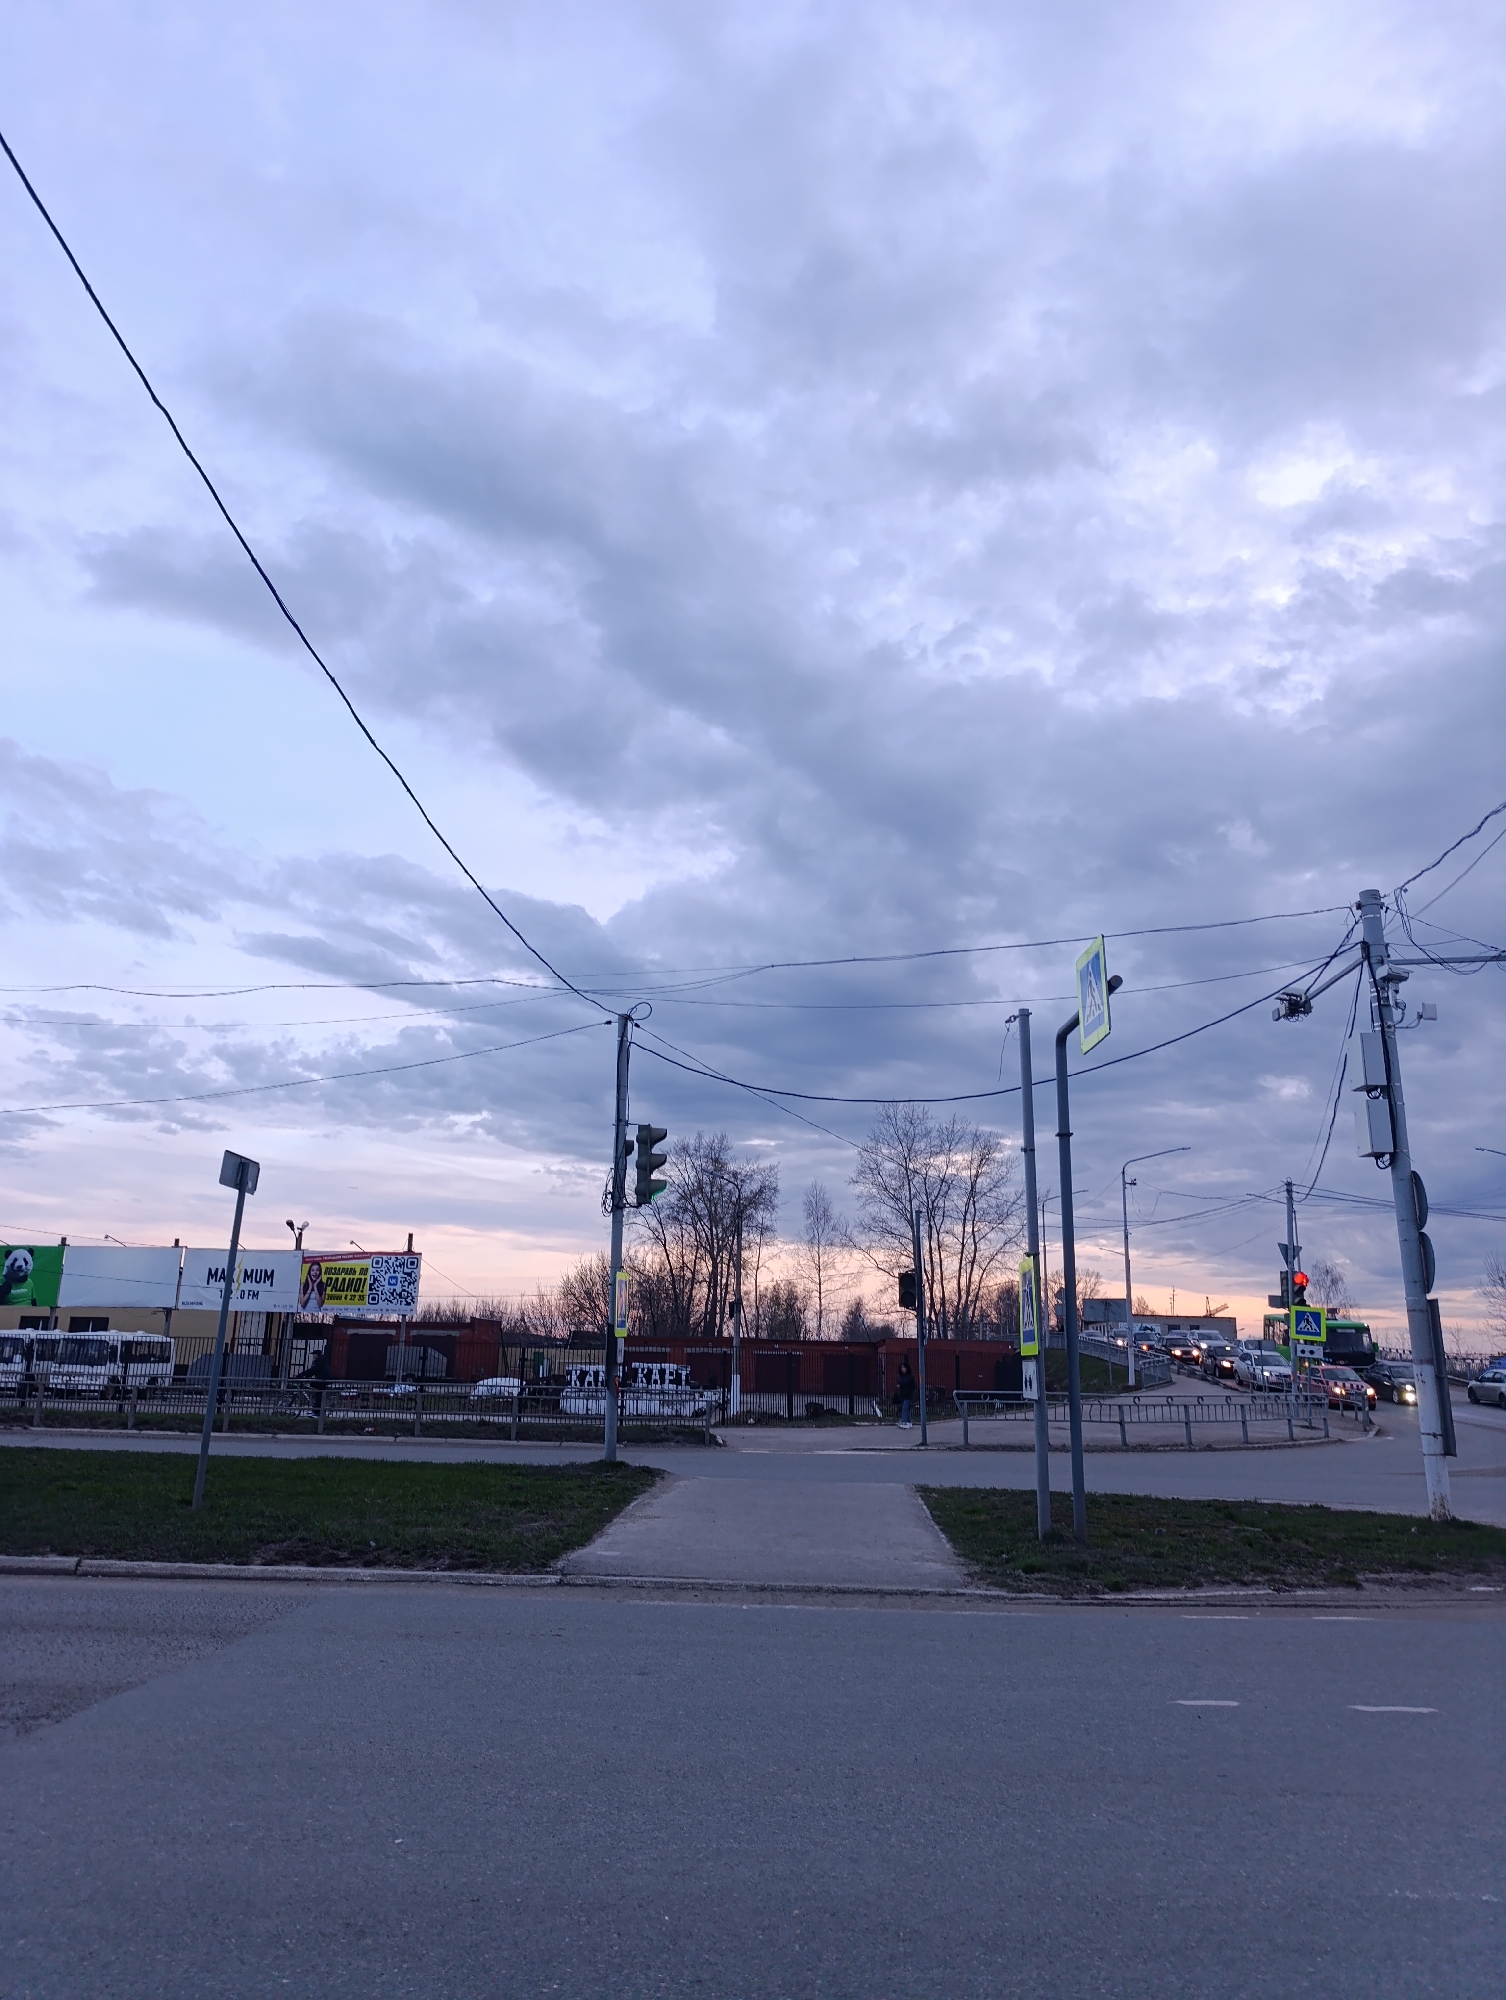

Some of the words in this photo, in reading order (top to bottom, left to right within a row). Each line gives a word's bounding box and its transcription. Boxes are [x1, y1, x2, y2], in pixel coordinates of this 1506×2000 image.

[324, 1266, 357, 1276] ПОЗДРАВЬ
[324, 1277, 367, 1293] РАДИО!
[247, 1290, 260, 1301] FM
